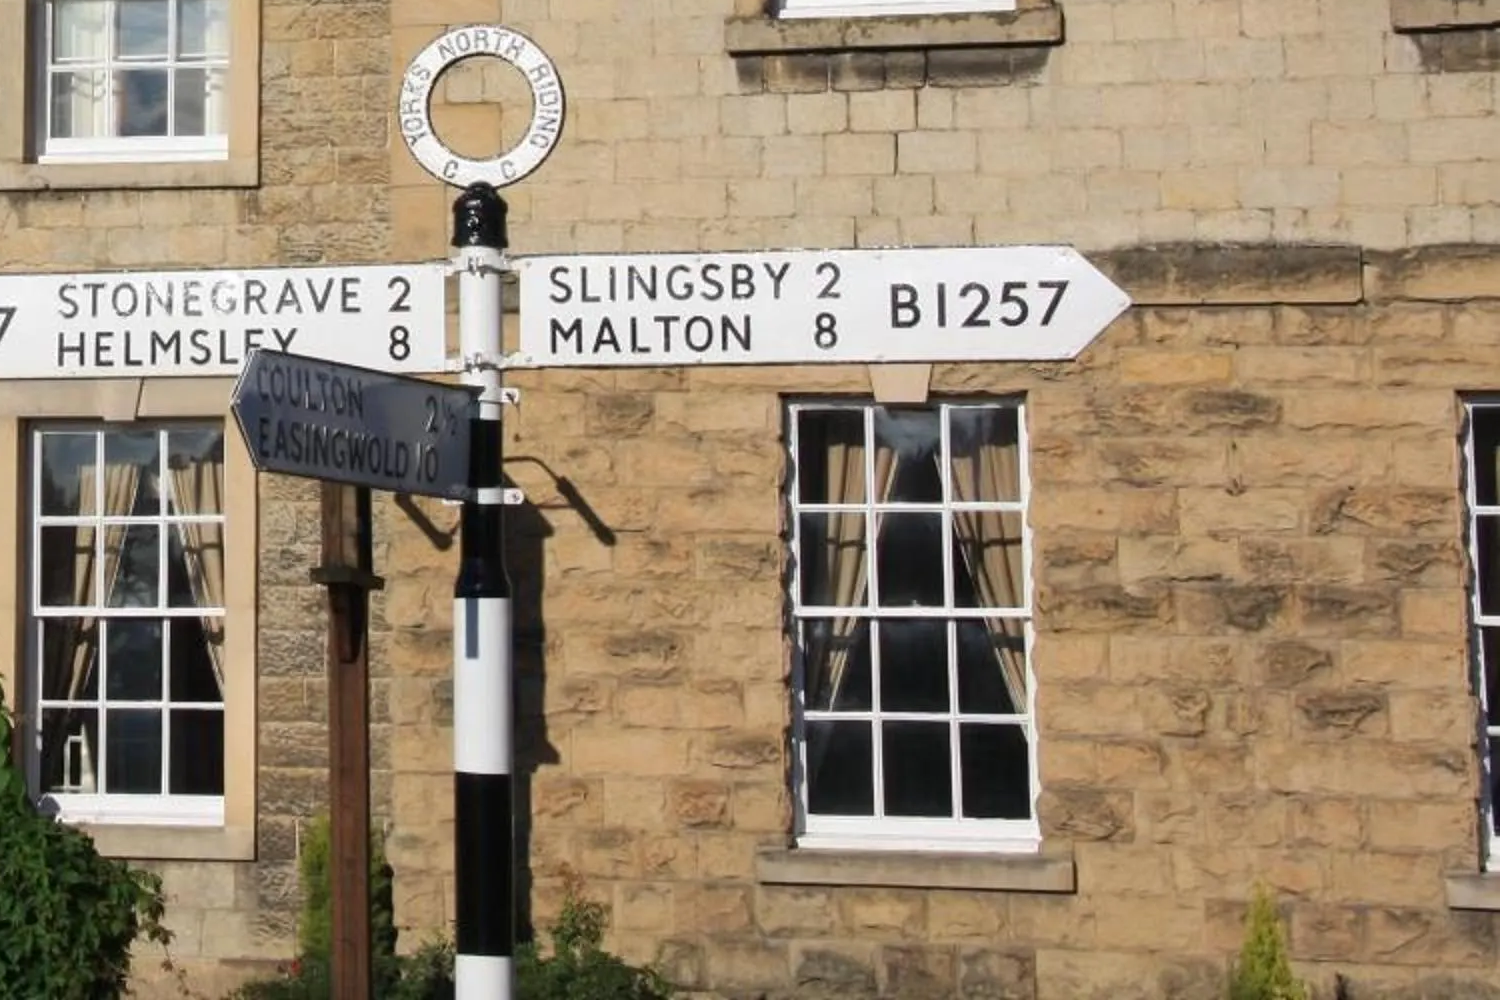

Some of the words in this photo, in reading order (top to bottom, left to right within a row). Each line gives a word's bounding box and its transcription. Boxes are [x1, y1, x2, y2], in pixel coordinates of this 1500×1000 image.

[401, 63, 431, 147] YORKS
[437, 29, 526, 61] NORTH
[443, 158, 459, 179] C
[500, 159, 517, 180] C
[57, 277, 362, 319] STONEGRAVE
[387, 275, 412, 313] 2
[548, 262, 791, 304] SLINGSBY
[815, 261, 842, 299] 2
[890, 280, 1070, 329] B1257
[57, 327, 297, 367] HELMSLEY
[388, 325, 411, 361] 8
[549, 314, 752, 354] MALTON
[814, 311, 838, 350] 8
[256, 363, 364, 420] COULTON
[257, 415, 409, 479] EASINGWOLD
